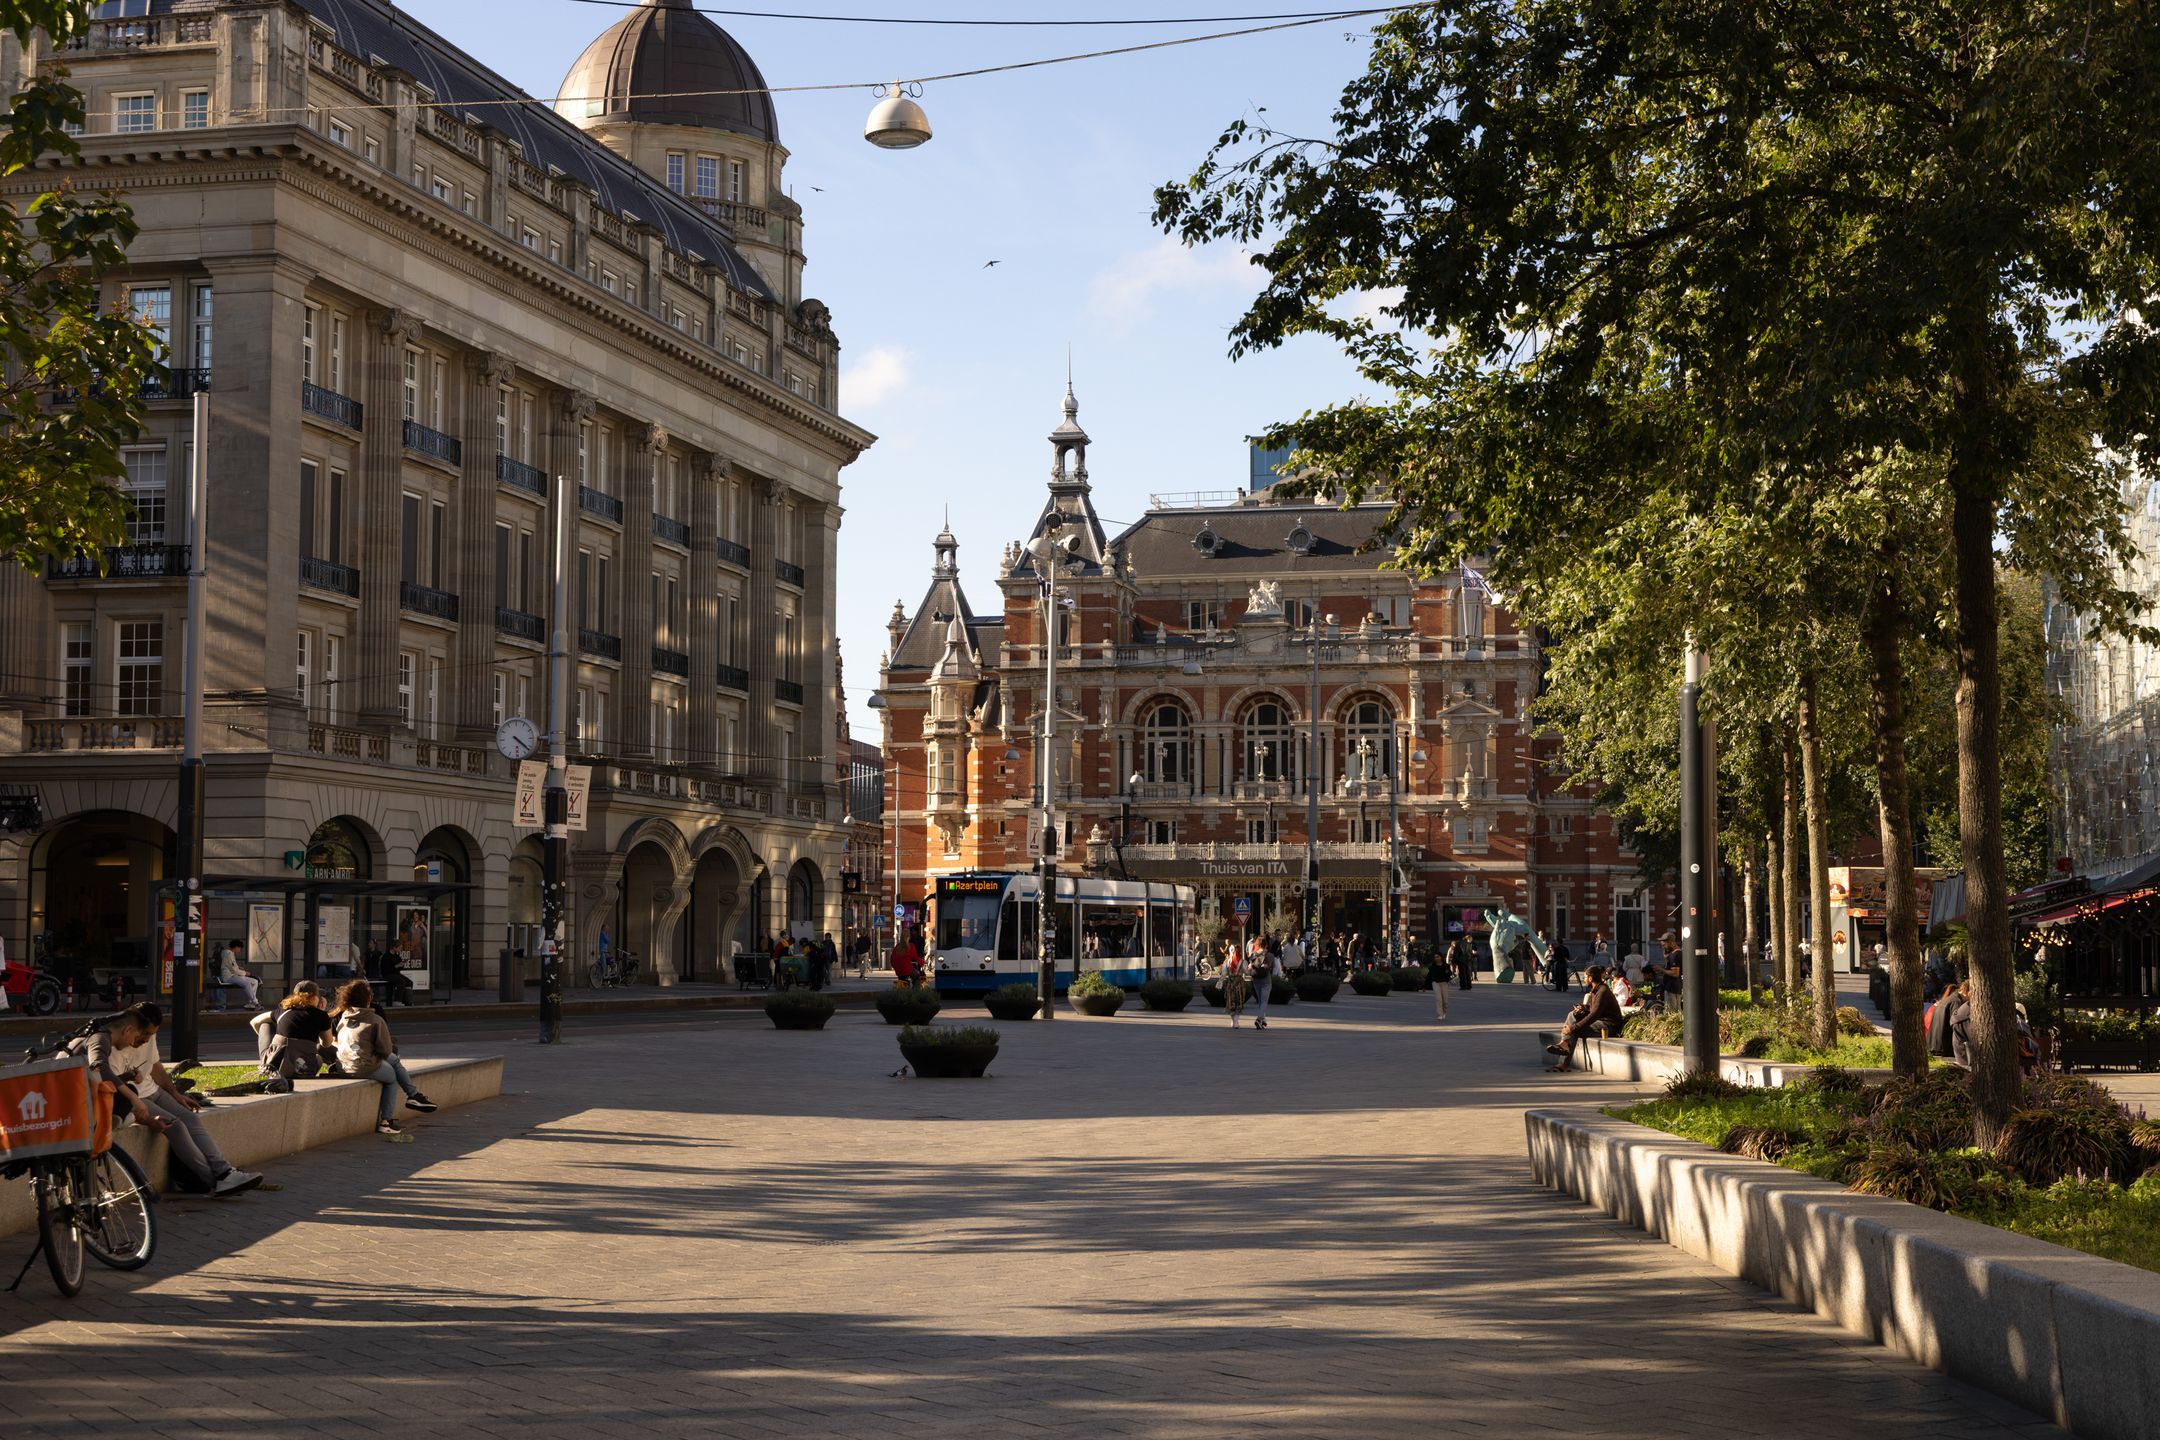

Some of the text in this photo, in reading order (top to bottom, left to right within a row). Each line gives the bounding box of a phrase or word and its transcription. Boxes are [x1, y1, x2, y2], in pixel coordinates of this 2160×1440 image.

[1200, 861, 1238, 874] Thuis
[1239, 864, 1264, 874] van
[1267, 861, 1288, 874] ITA
[955, 880, 998, 892] Azartplein
